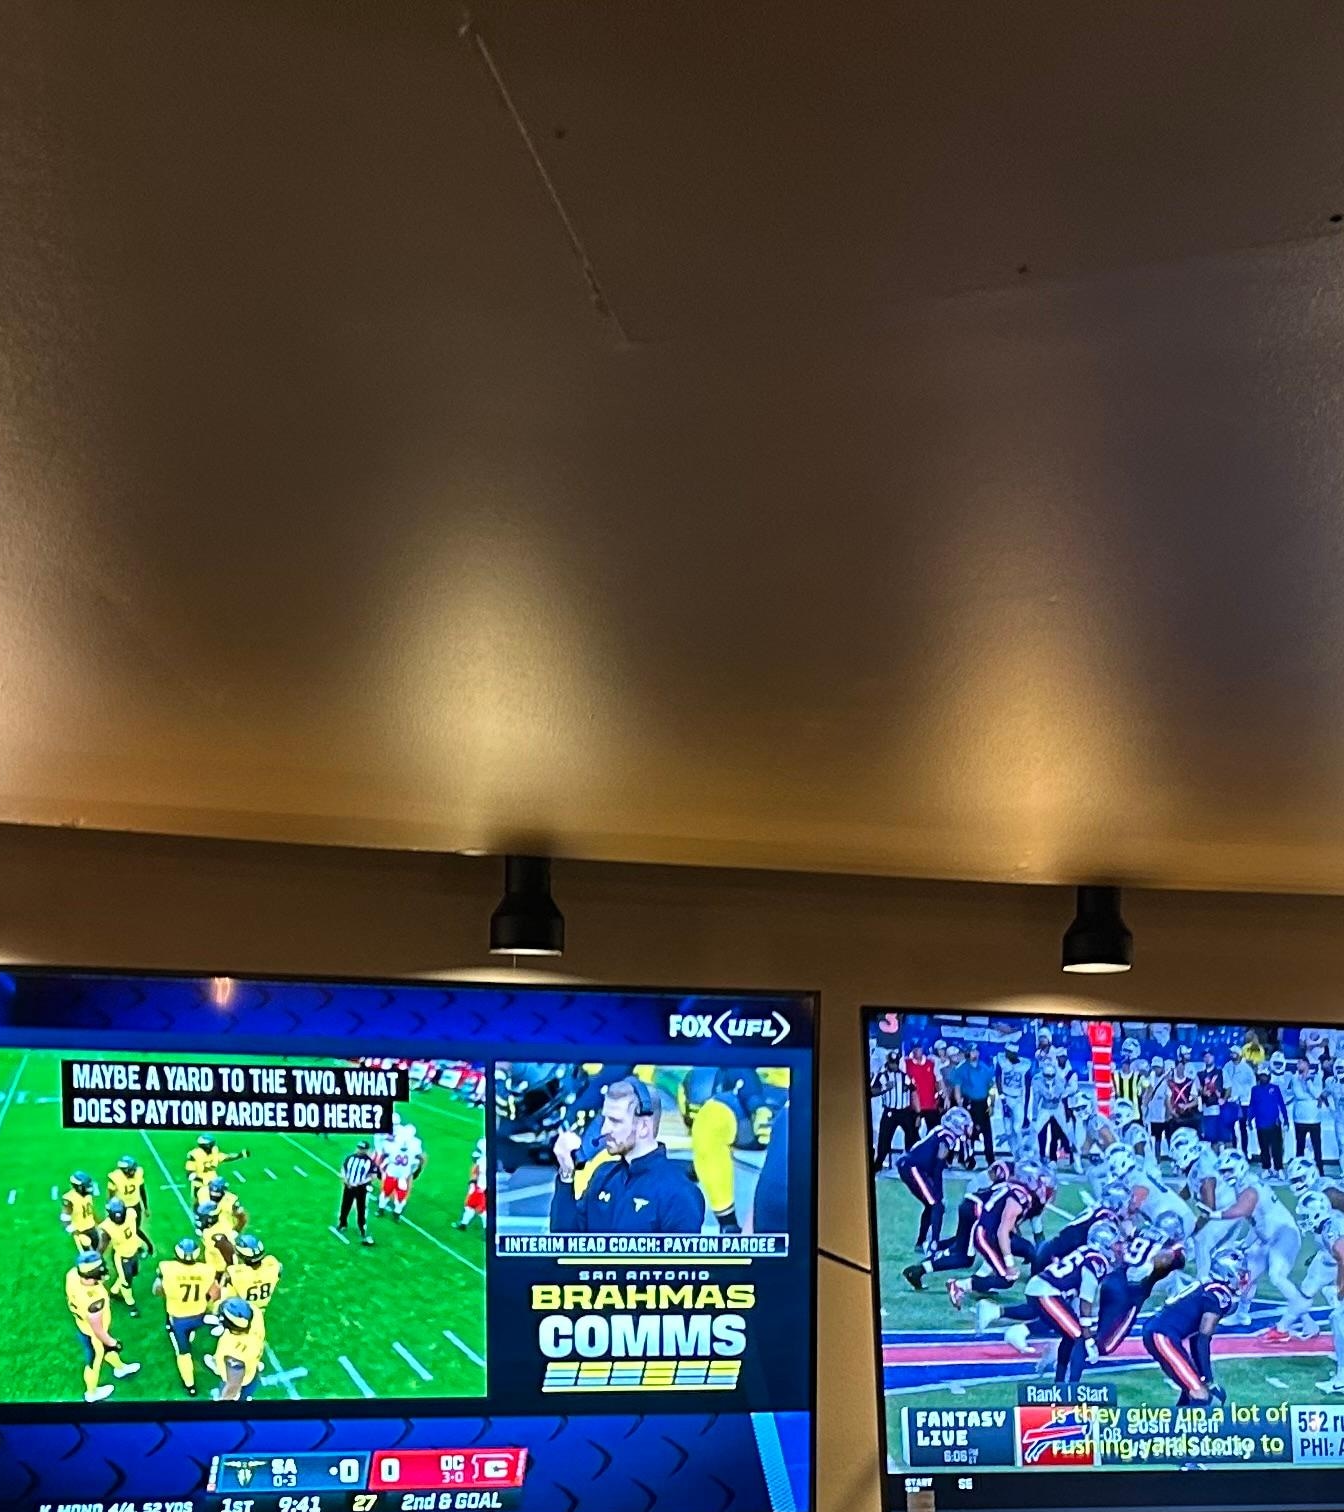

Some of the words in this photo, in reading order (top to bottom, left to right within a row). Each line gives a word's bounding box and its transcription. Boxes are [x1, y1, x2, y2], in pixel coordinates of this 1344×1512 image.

[669, 1014, 713, 1038] FOX
[726, 1018, 777, 1037] UFL
[72, 1064, 140, 1090] MAYBE
[146, 1065, 161, 1091] A
[164, 1066, 213, 1092] YARD
[218, 1067, 244, 1093] TO
[250, 1068, 285, 1094] THE
[292, 1069, 341, 1095] TWO.
[344, 1071, 399, 1096] WHAT
[73, 1098, 126, 1124] DOES
[131, 1099, 207, 1126] PAYTON
[212, 1101, 289, 1127] PARDEE
[294, 1103, 320, 1128] DO
[323, 1103, 383, 1129] HERE?
[505, 1236, 564, 1252] INTERIM
[568, 1237, 606, 1253] HEAD
[609, 1237, 661, 1253] COACH:
[664, 1238, 718, 1253] PAYTON
[722, 1238, 776, 1253] PARDEE
[579, 1271, 617, 1281] SAN
[626, 1271, 710, 1281] ANTONIO
[531, 1284, 756, 1310] BRAHMAS
[539, 1315, 747, 1358] COMMS
[1027, 1386, 1060, 1402] Rank
[1076, 1386, 1108, 1402] Start
[916, 1411, 1006, 1428] FANTASY
[1298, 1411, 1328, 1432] 552
[917, 1429, 968, 1446] LIVE
[1299, 1435, 1334, 1457] PHI:
[353, 1494, 377, 1511] 27
[401, 1493, 435, 1511] 2nd
[439, 1493, 452, 1509] &
[455, 1491, 502, 1509] GOAL
